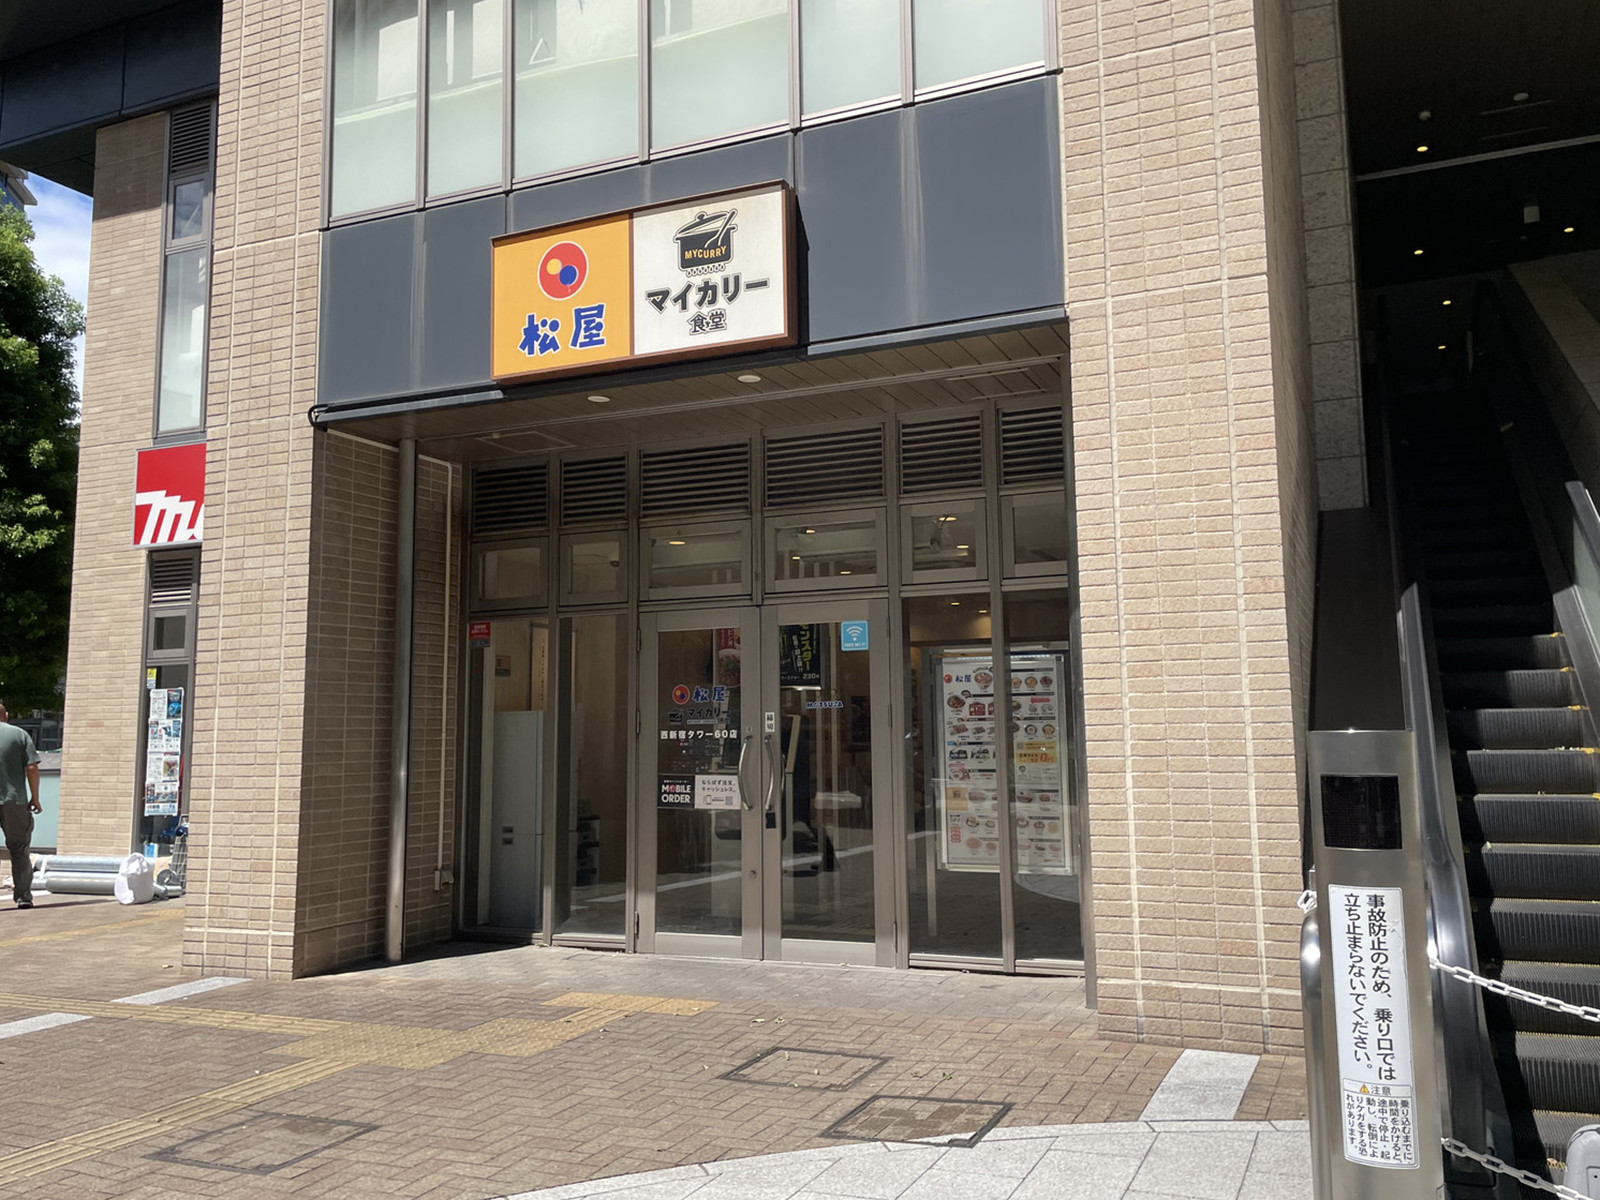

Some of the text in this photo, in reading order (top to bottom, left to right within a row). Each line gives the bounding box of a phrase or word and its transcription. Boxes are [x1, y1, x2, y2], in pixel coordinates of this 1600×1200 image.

[684, 245, 728, 260] MYCURRY
[646, 274, 769, 312] マイカリー
[518, 304, 606, 356] 松屋
[689, 312, 726, 334] 食堂
[693, 685, 727, 702] 松屋
[686, 706, 731, 718] マイカリー
[660, 729, 738, 740] 西新宿タワー60店
[661, 784, 692, 793] MOBILE
[661, 793, 691, 804] ORDER
[1344, 893, 1373, 1069] 立ち止まらないでください。
[1366, 894, 1397, 1081] 事故防止のため、乗り口では
[1371, 1085, 1392, 1096] 注意
[1345, 1093, 1357, 1149] れがあります。
[1356, 1095, 1368, 1157] りケガをする恐
[1400, 1099, 1413, 1161] 乗り込むまでに
